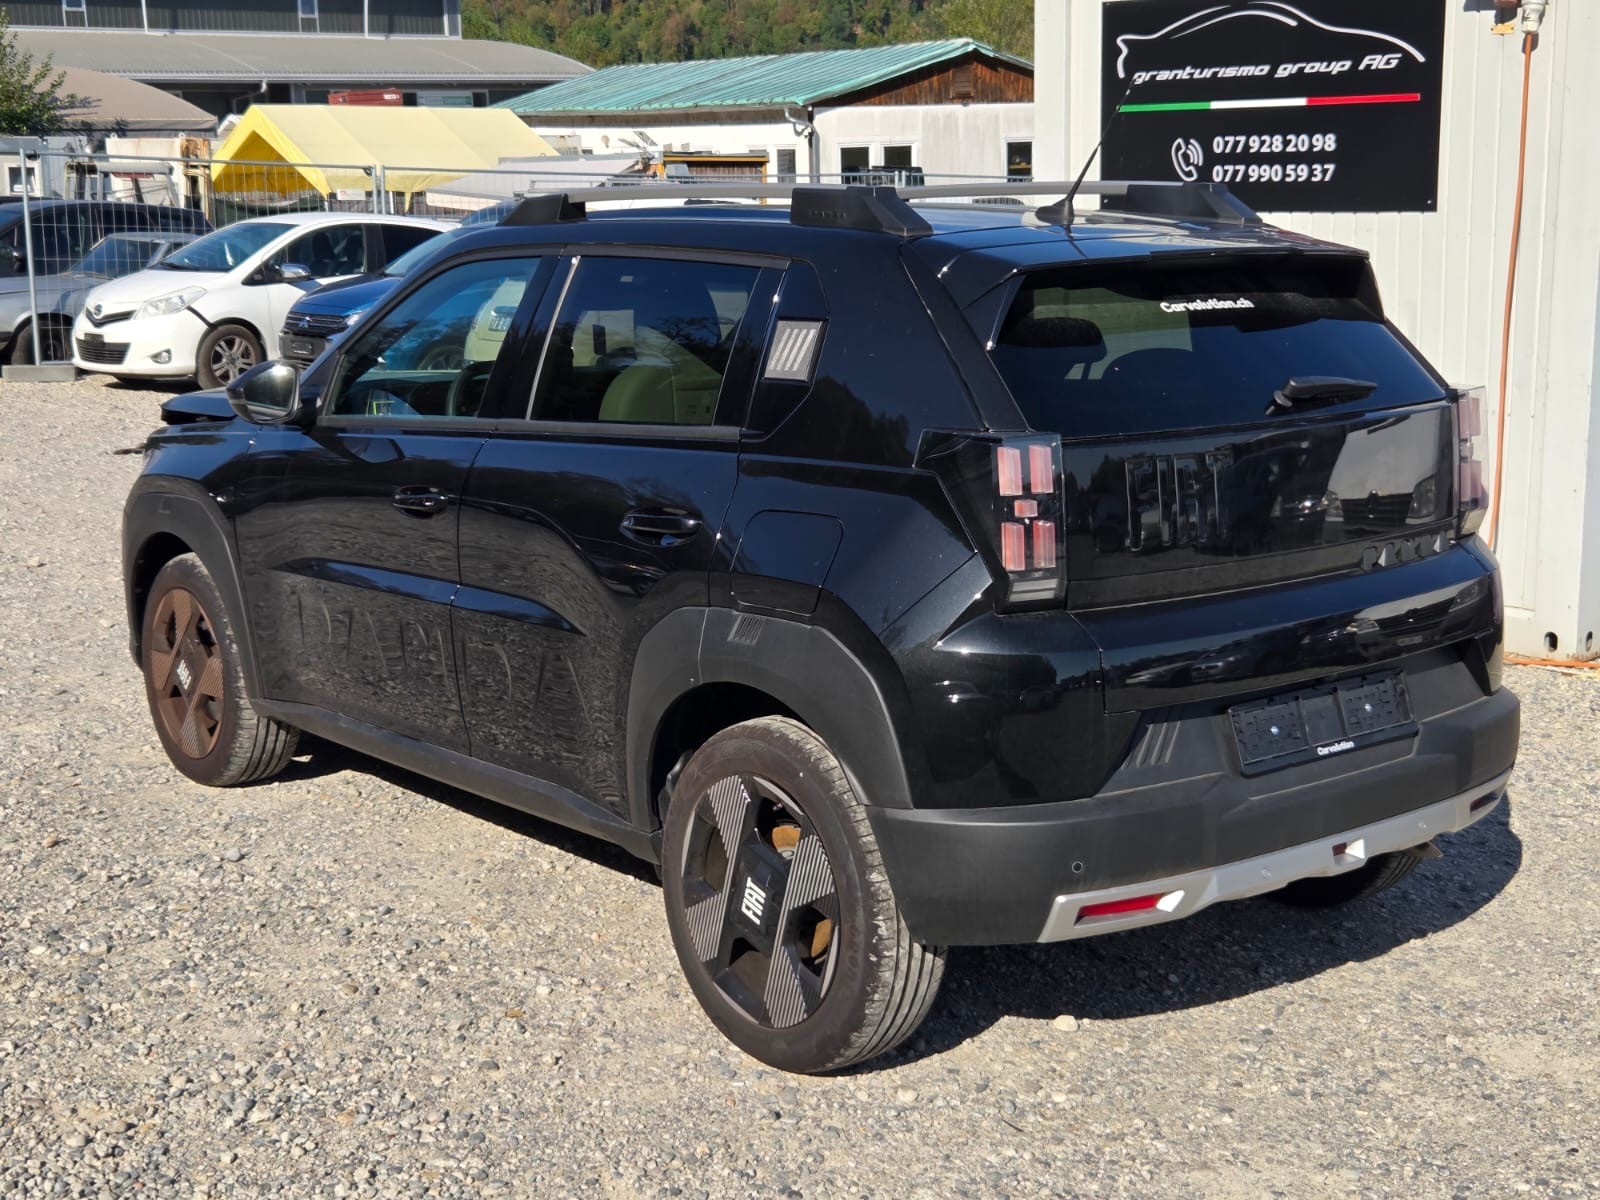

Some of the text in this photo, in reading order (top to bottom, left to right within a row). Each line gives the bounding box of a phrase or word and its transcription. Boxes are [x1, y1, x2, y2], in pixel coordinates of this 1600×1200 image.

[1133, 53, 1402, 85] granturismo group AG
[1212, 133, 1336, 154] 077 928 20 98
[1212, 164, 1335, 183] 077 990 59 37
[1159, 296, 1255, 314] Carvolution.ch
[1316, 741, 1355, 756] Carvolution
[741, 876, 768, 926] FIAT
